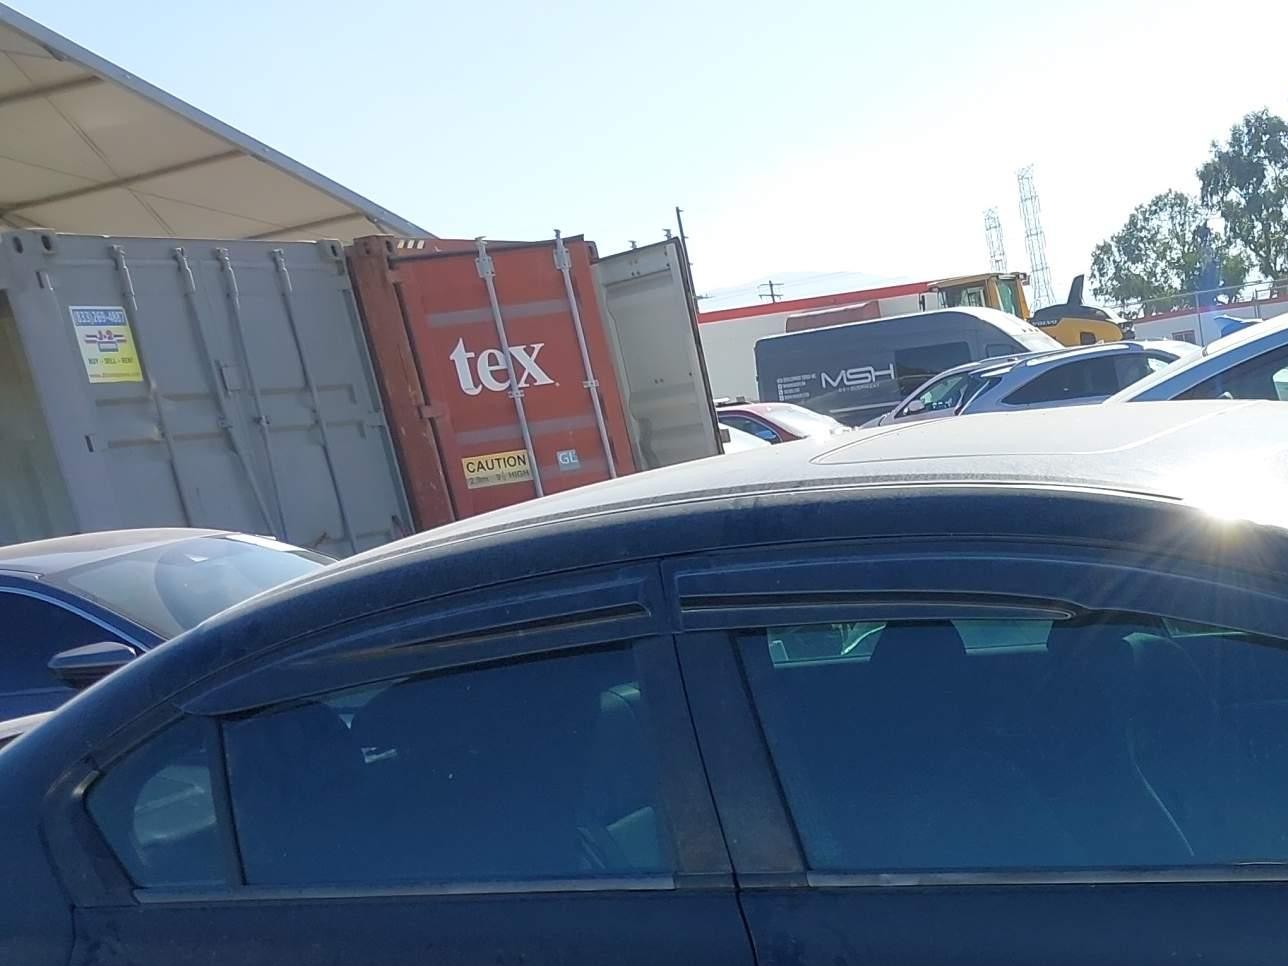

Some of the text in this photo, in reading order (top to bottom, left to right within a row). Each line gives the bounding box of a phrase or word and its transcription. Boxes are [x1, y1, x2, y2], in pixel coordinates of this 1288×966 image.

[449, 336, 555, 396] tex
[820, 363, 895, 389] MSH
[466, 454, 527, 474] CAUTION
[559, 452, 578, 465] GL
[509, 469, 530, 480] HIGH
